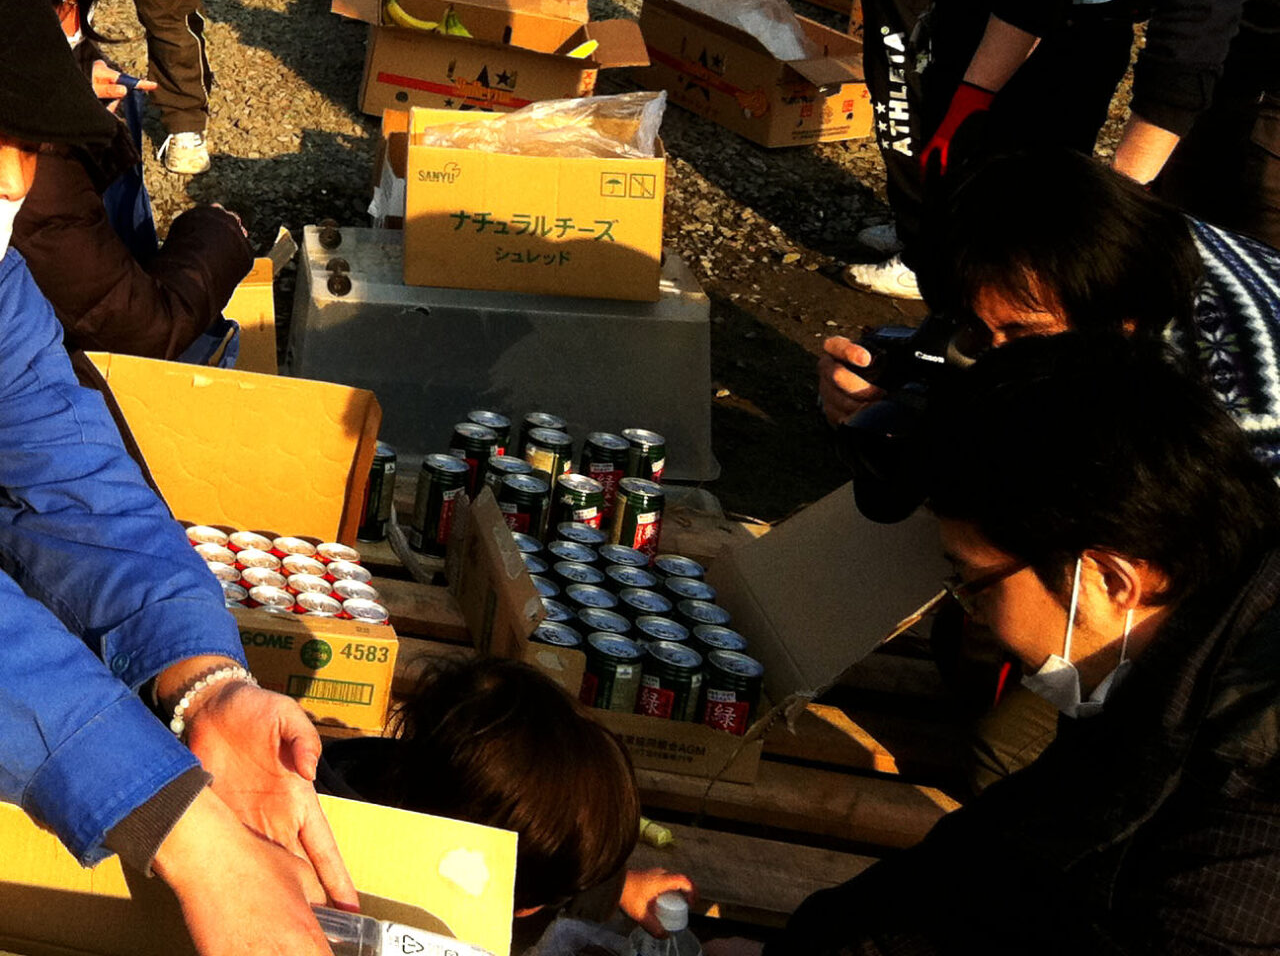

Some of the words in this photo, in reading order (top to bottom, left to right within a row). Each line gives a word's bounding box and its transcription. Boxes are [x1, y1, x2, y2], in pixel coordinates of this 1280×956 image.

[883, 31, 914, 157] ATHLETA
[418, 170, 455, 184] SANYU
[450, 210, 620, 242] ナチュラルチーズ
[495, 247, 572, 266] シュレッド
[339, 642, 390, 663] 4583
